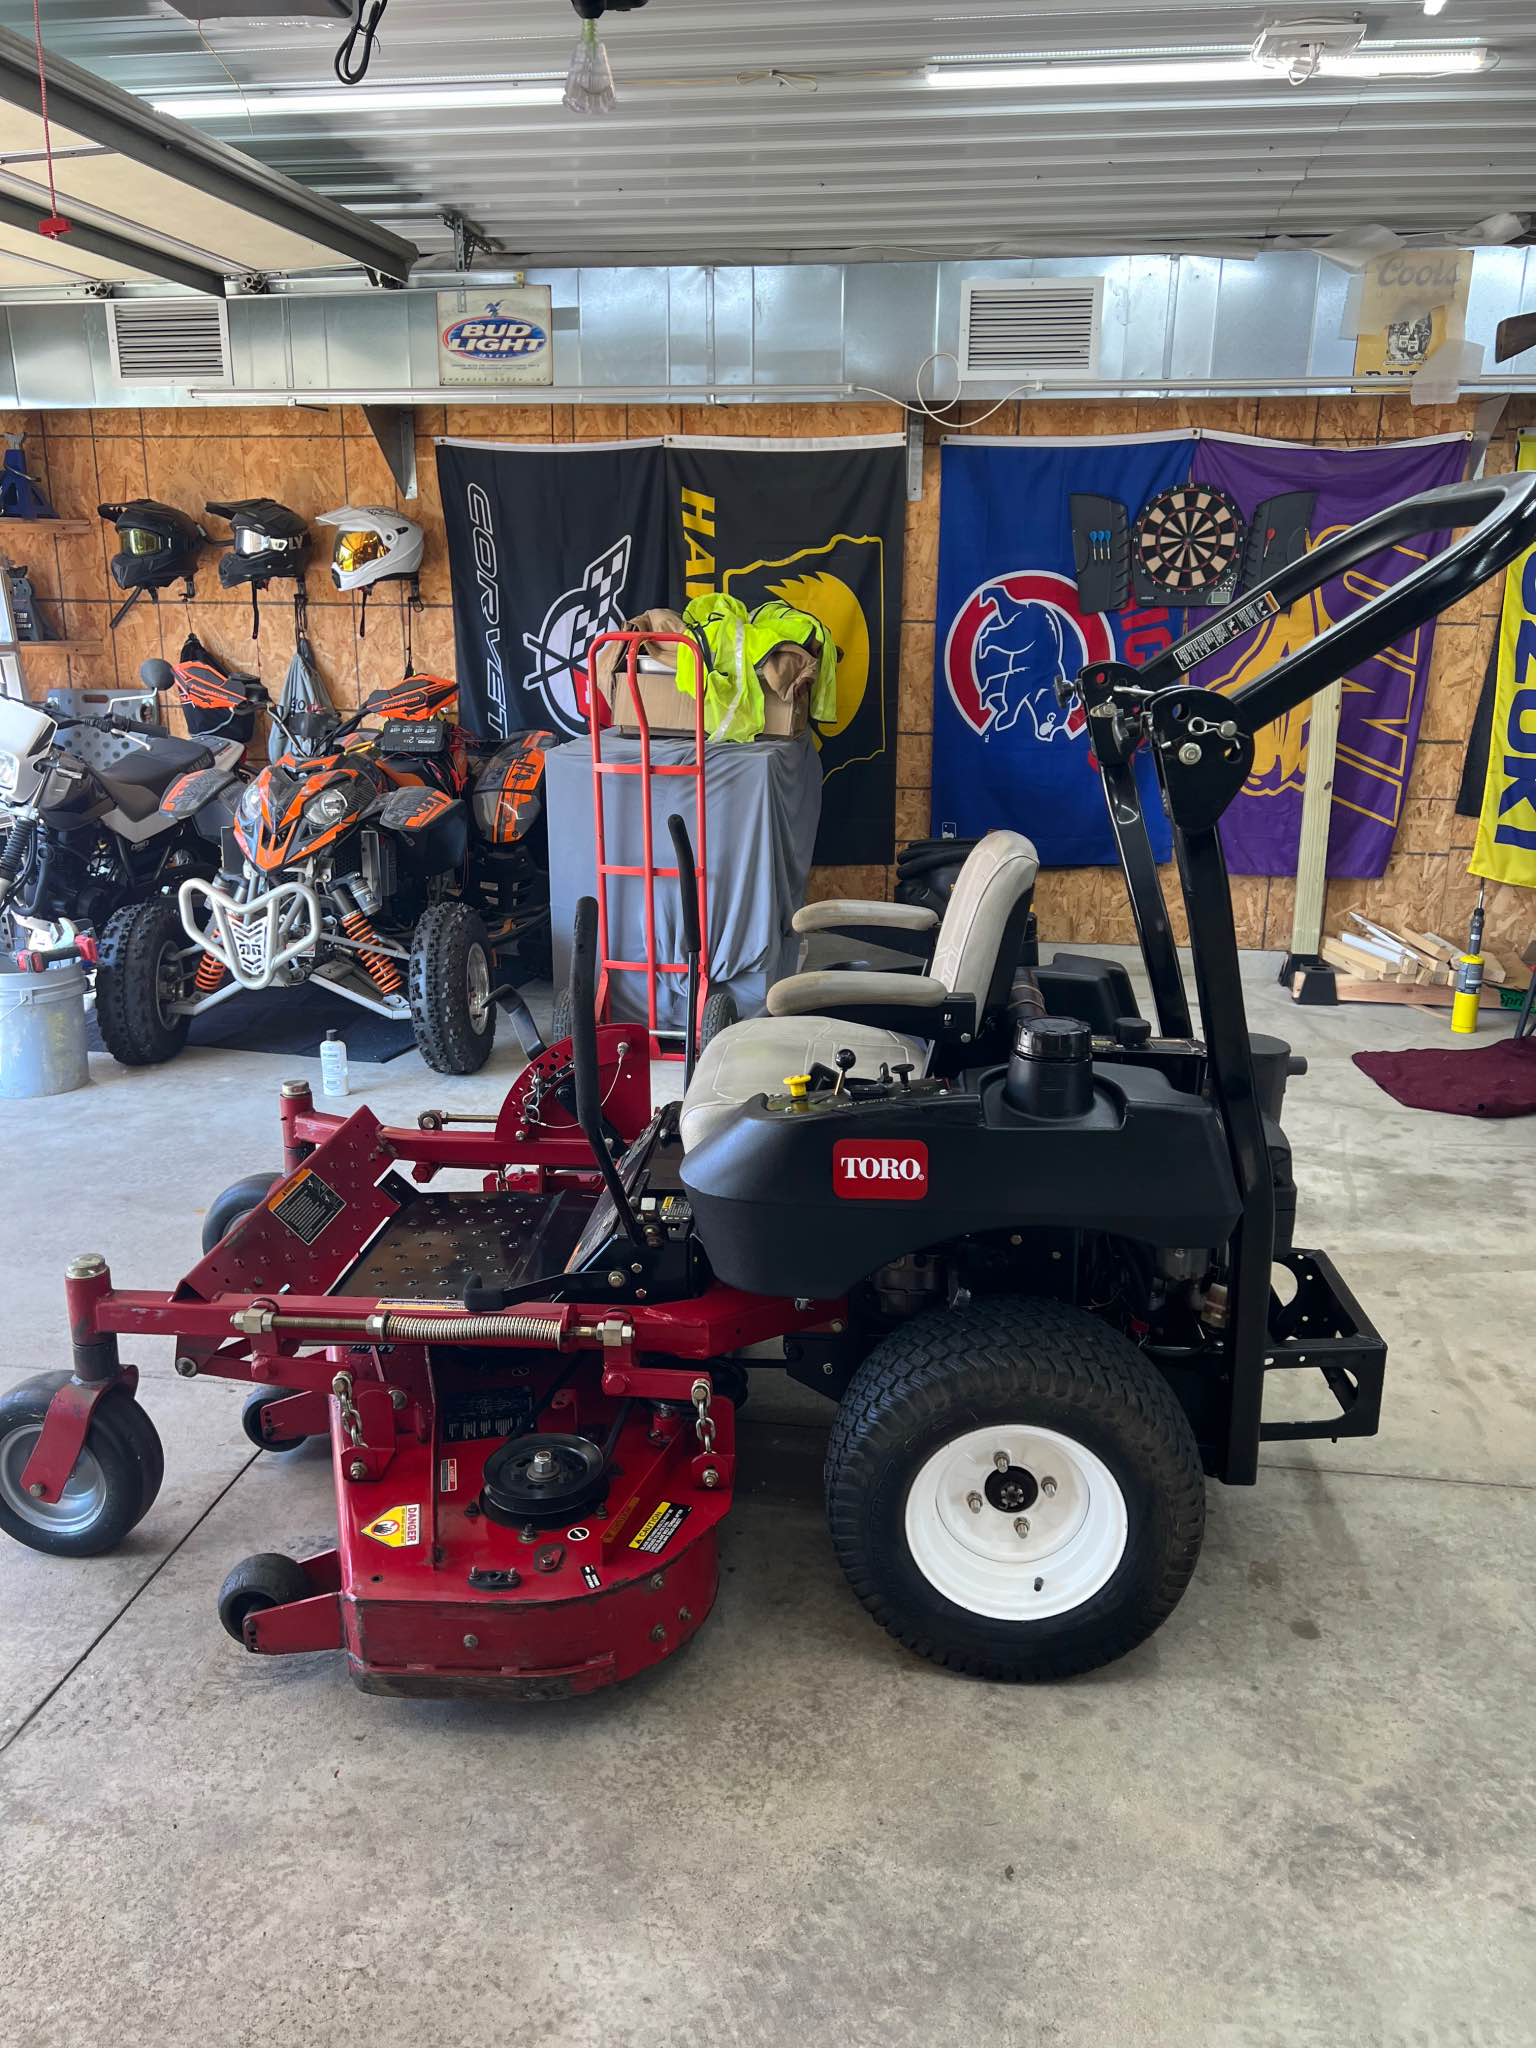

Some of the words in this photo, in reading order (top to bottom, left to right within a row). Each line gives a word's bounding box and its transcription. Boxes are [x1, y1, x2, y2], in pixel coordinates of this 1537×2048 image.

[461, 324, 532, 337] BUD
[448, 338, 545, 351] LIGHT
[841, 1157, 920, 1180] TORO
[407, 1507, 418, 1542] DANGER
[639, 1511, 663, 1537] CAUTION
